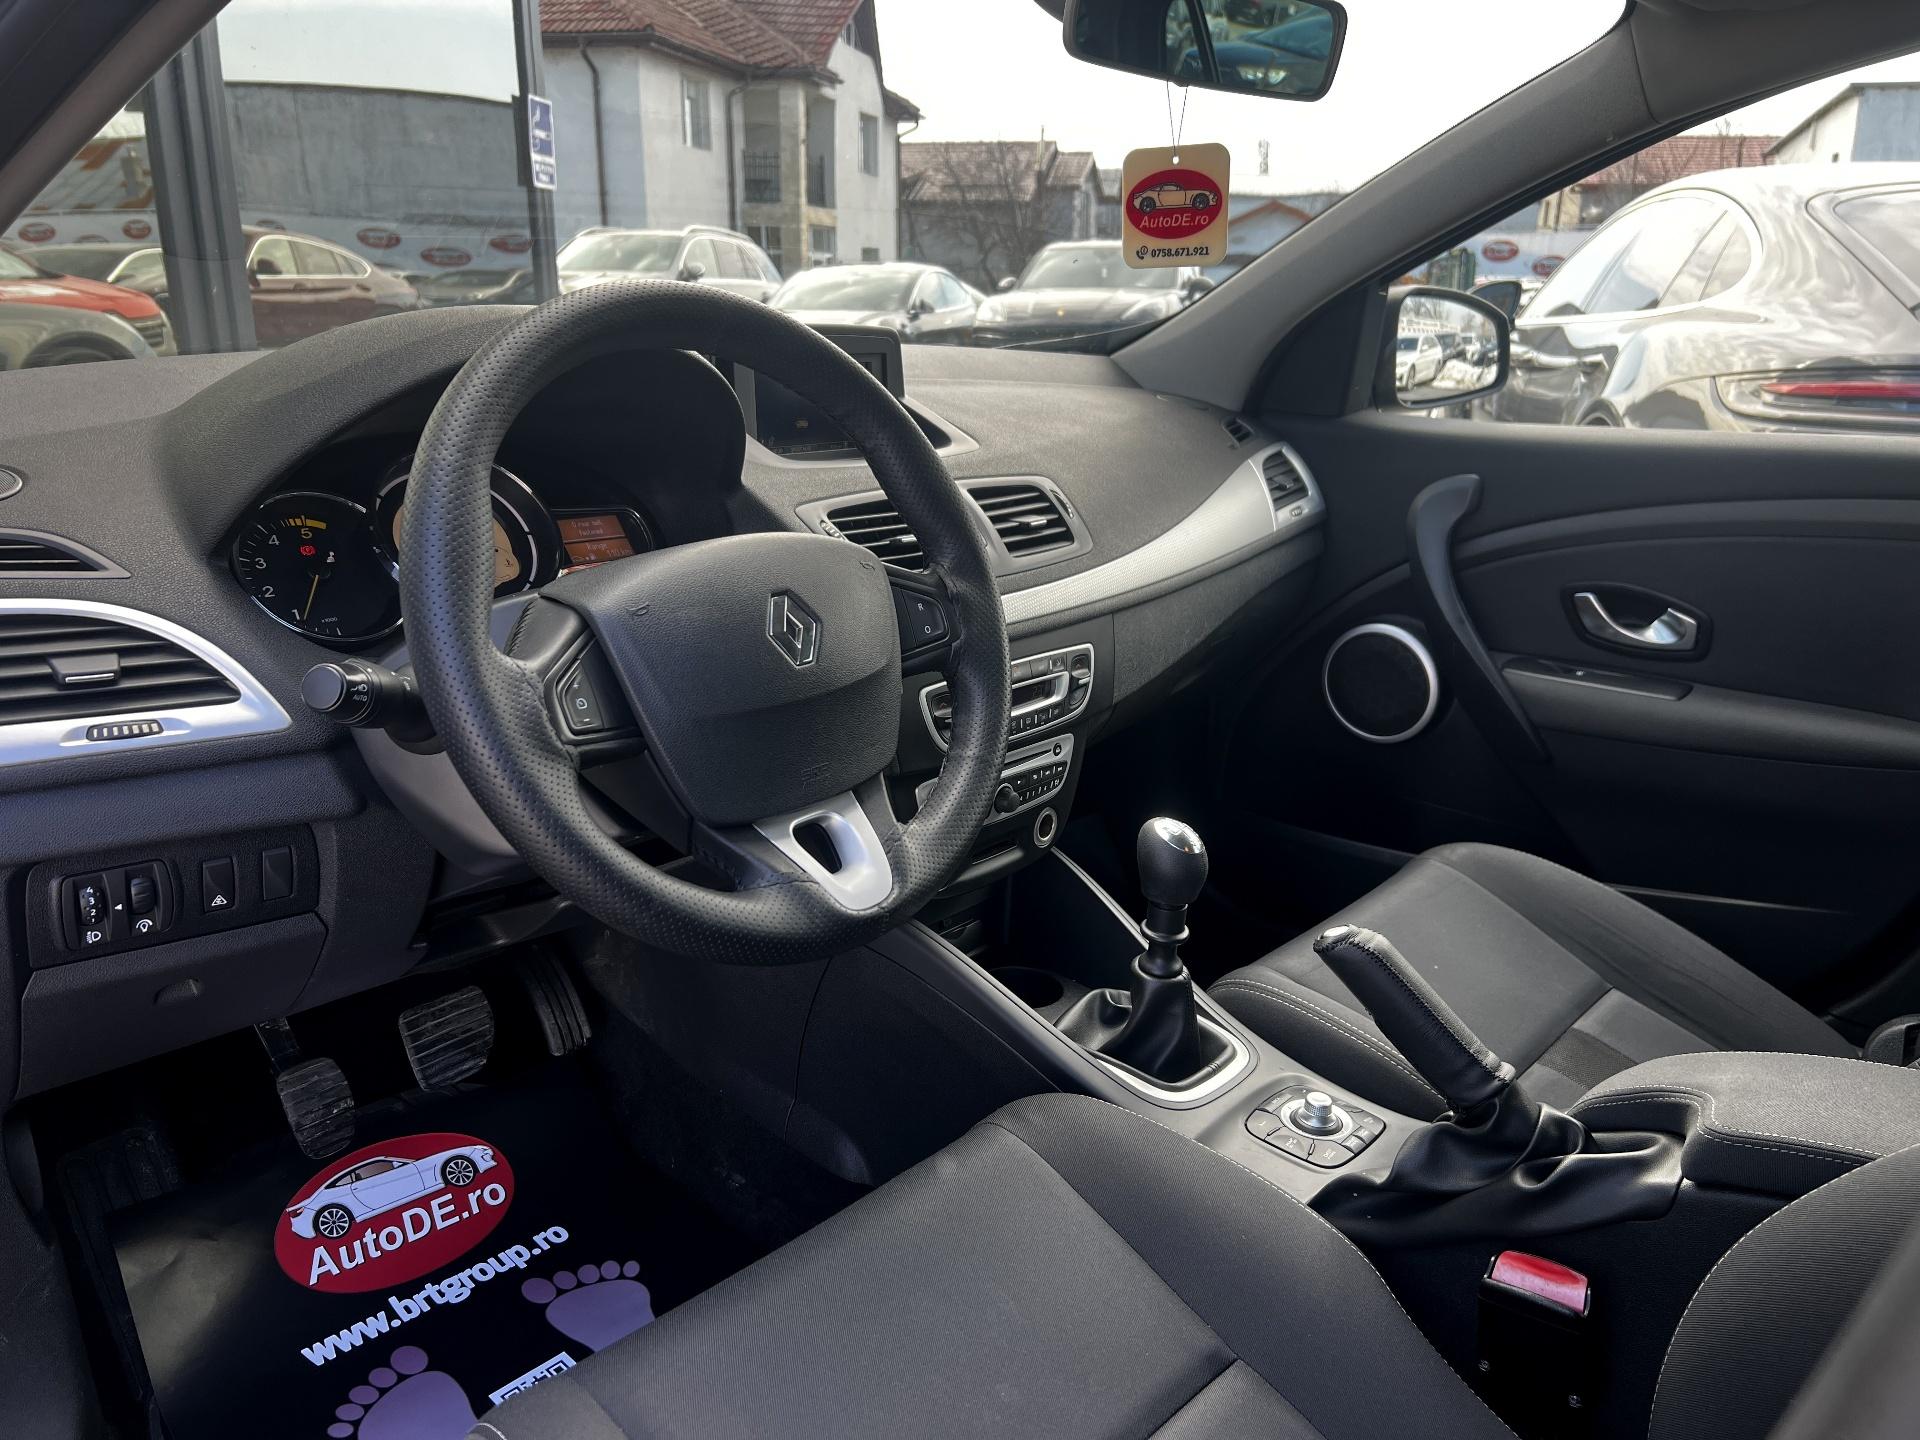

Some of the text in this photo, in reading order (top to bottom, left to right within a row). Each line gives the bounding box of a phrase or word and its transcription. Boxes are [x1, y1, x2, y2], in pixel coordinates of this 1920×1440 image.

[1140, 213, 1209, 229] AutoDE.ro
[1151, 246, 1210, 258] 0758.671.921
[300, 527, 313, 539] 5
[268, 534, 280, 546] 4
[254, 557, 267, 569] 3
[262, 585, 276, 598] 2
[291, 608, 301, 621] 1
[352, 694, 368, 702] AUTO
[88, 896, 95, 905] 3
[90, 908, 97, 916] 2
[308, 1182, 507, 1287] AutoDE.ro
[301, 1225, 570, 1367] www.brtgroup.ro
